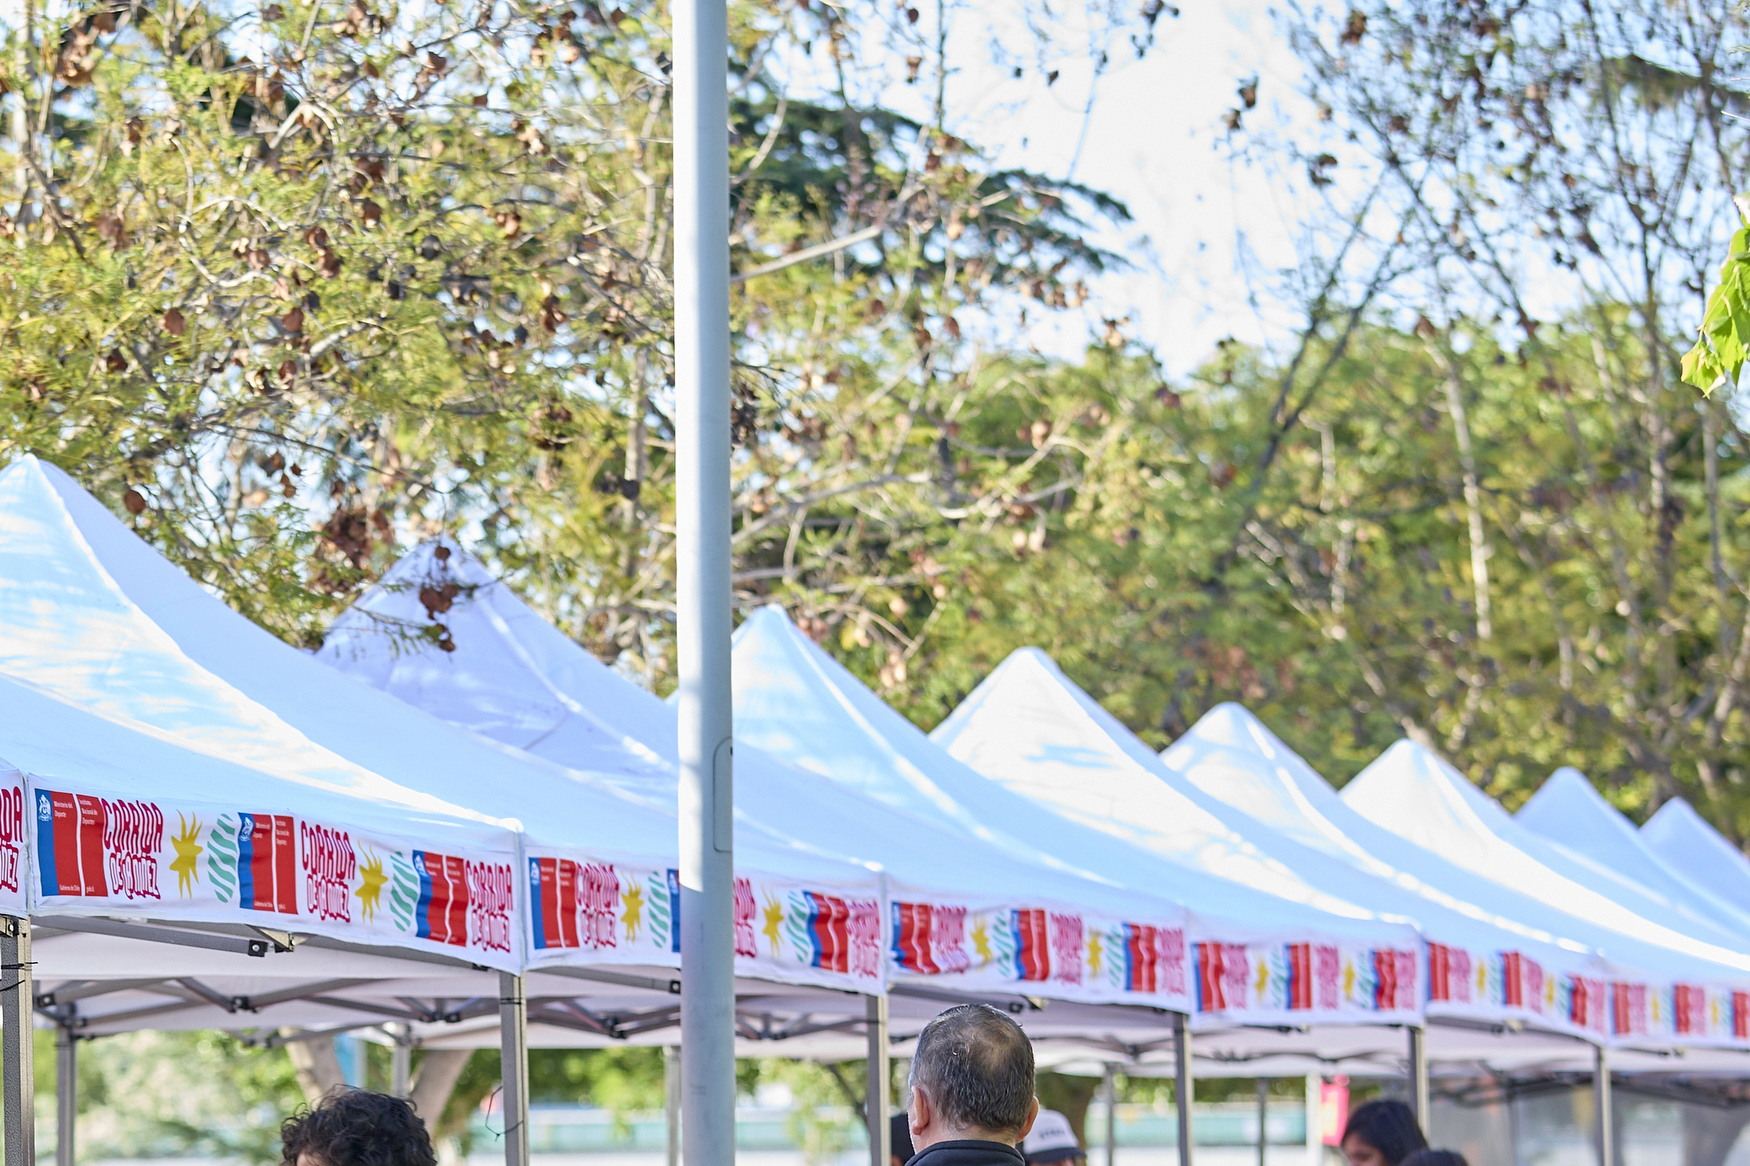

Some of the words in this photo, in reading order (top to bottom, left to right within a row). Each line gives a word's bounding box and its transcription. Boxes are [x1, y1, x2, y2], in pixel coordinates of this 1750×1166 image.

[102, 798, 163, 854] CORRIDA
[109, 851, 123, 895] DE
[122, 852, 134, 899] LA
